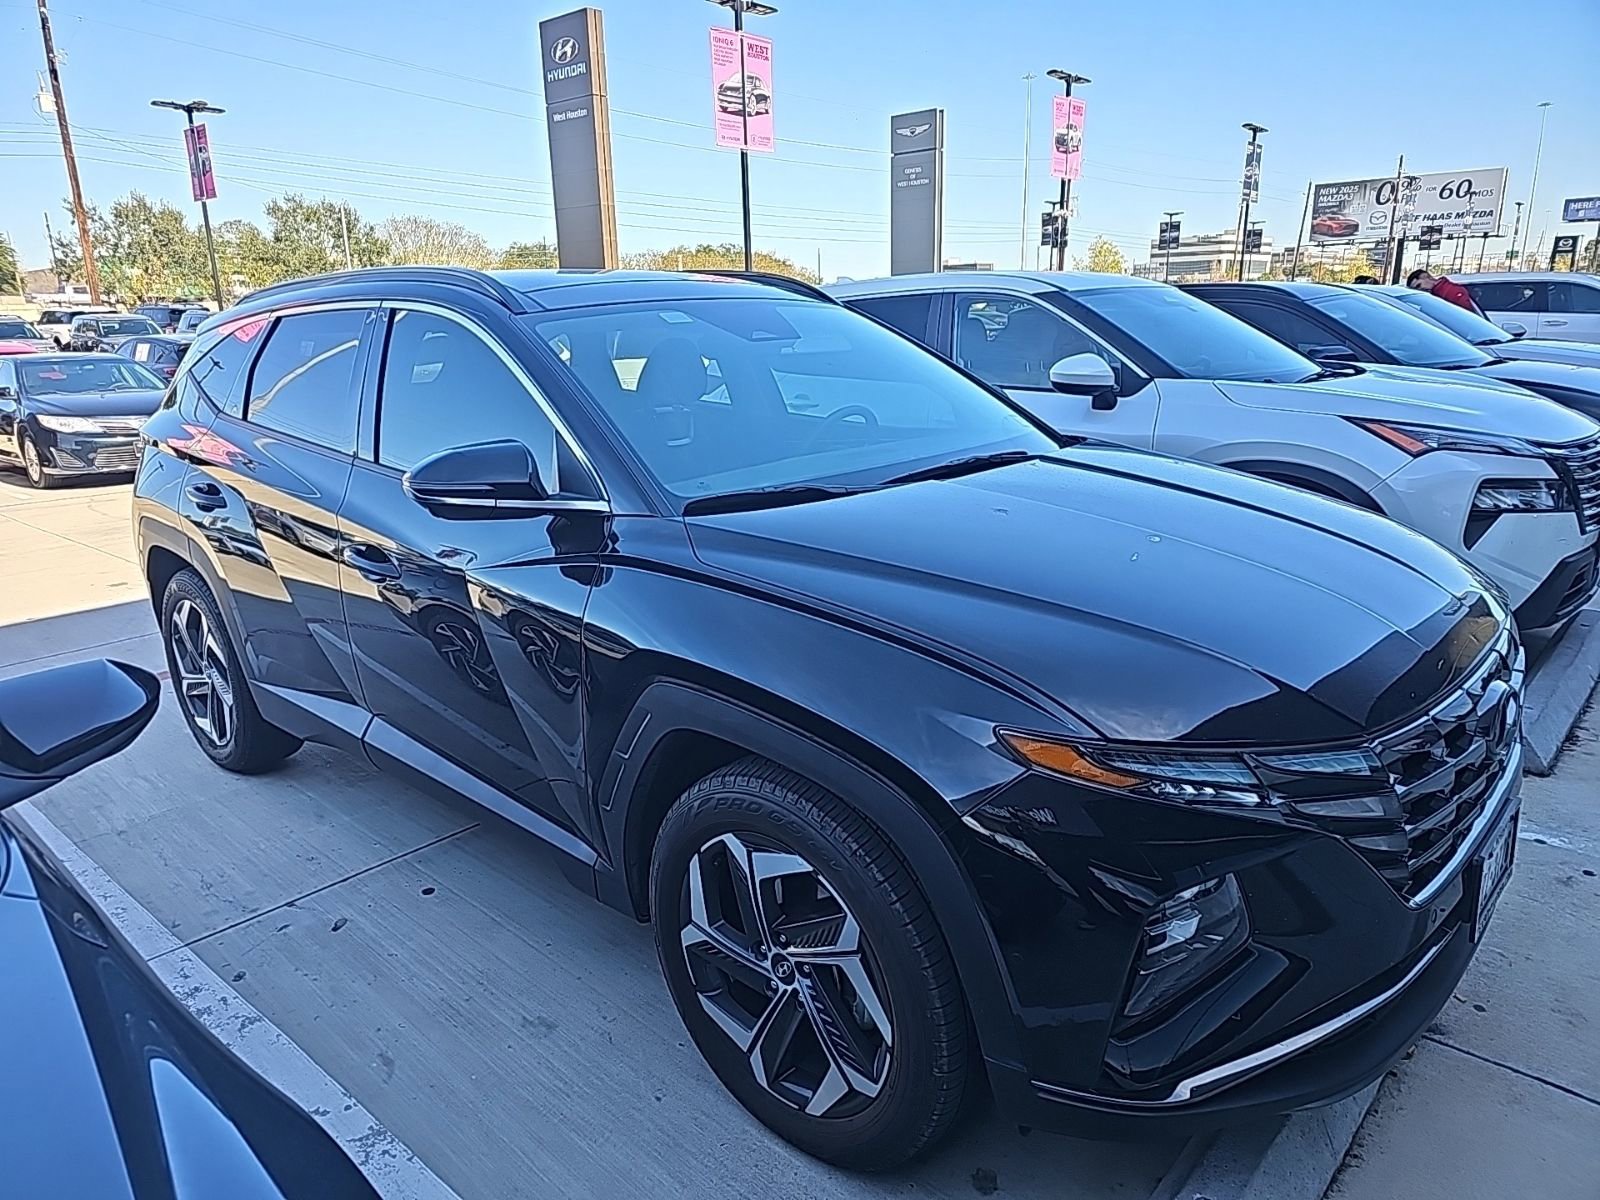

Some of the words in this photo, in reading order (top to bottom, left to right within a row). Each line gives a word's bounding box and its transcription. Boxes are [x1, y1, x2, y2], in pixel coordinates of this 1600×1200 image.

[746, 42, 769, 55] WEST
[547, 62, 587, 83] HYUNDAI
[552, 112, 566, 122] West
[566, 108, 588, 120] Houston
[908, 178, 930, 186] HOUSTON
[1319, 187, 1338, 196] NEW
[1338, 184, 1360, 194] 2025
[1438, 179, 1473, 200] 60
[1318, 193, 1354, 203] MAZDA3
[1570, 201, 1595, 210] HERE
[1422, 212, 1453, 222] HAAS
[1454, 209, 1494, 220] MZDA
